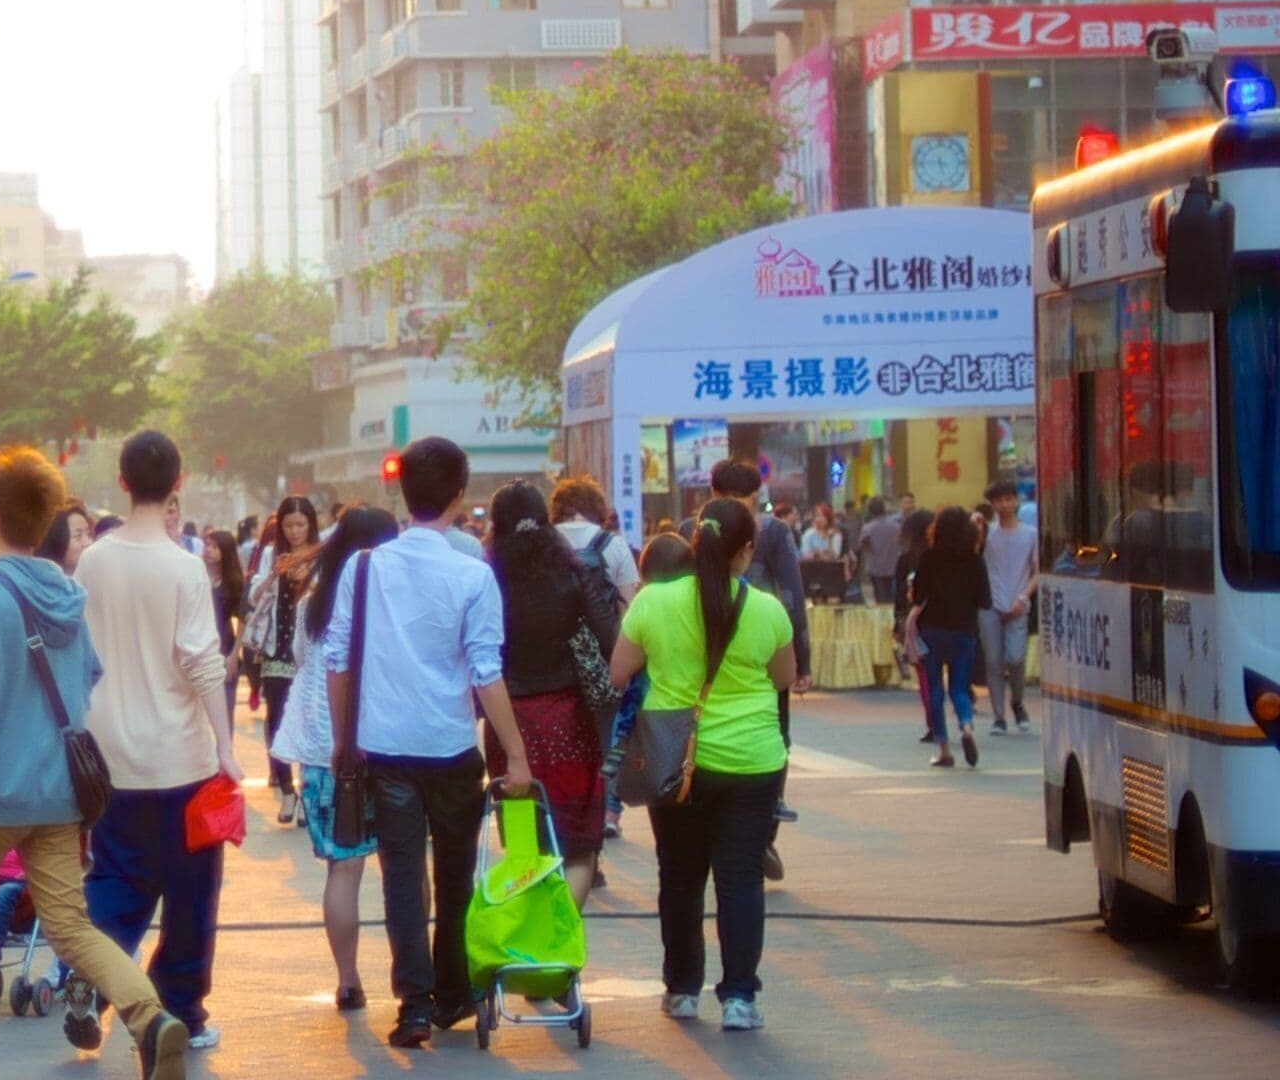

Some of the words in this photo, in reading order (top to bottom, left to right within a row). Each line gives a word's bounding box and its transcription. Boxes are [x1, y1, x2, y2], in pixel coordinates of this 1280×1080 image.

[924, 10, 1076, 54] 骏亿
[693, 356, 872, 400] 海景摄影
[1067, 607, 1111, 670] POLICE
